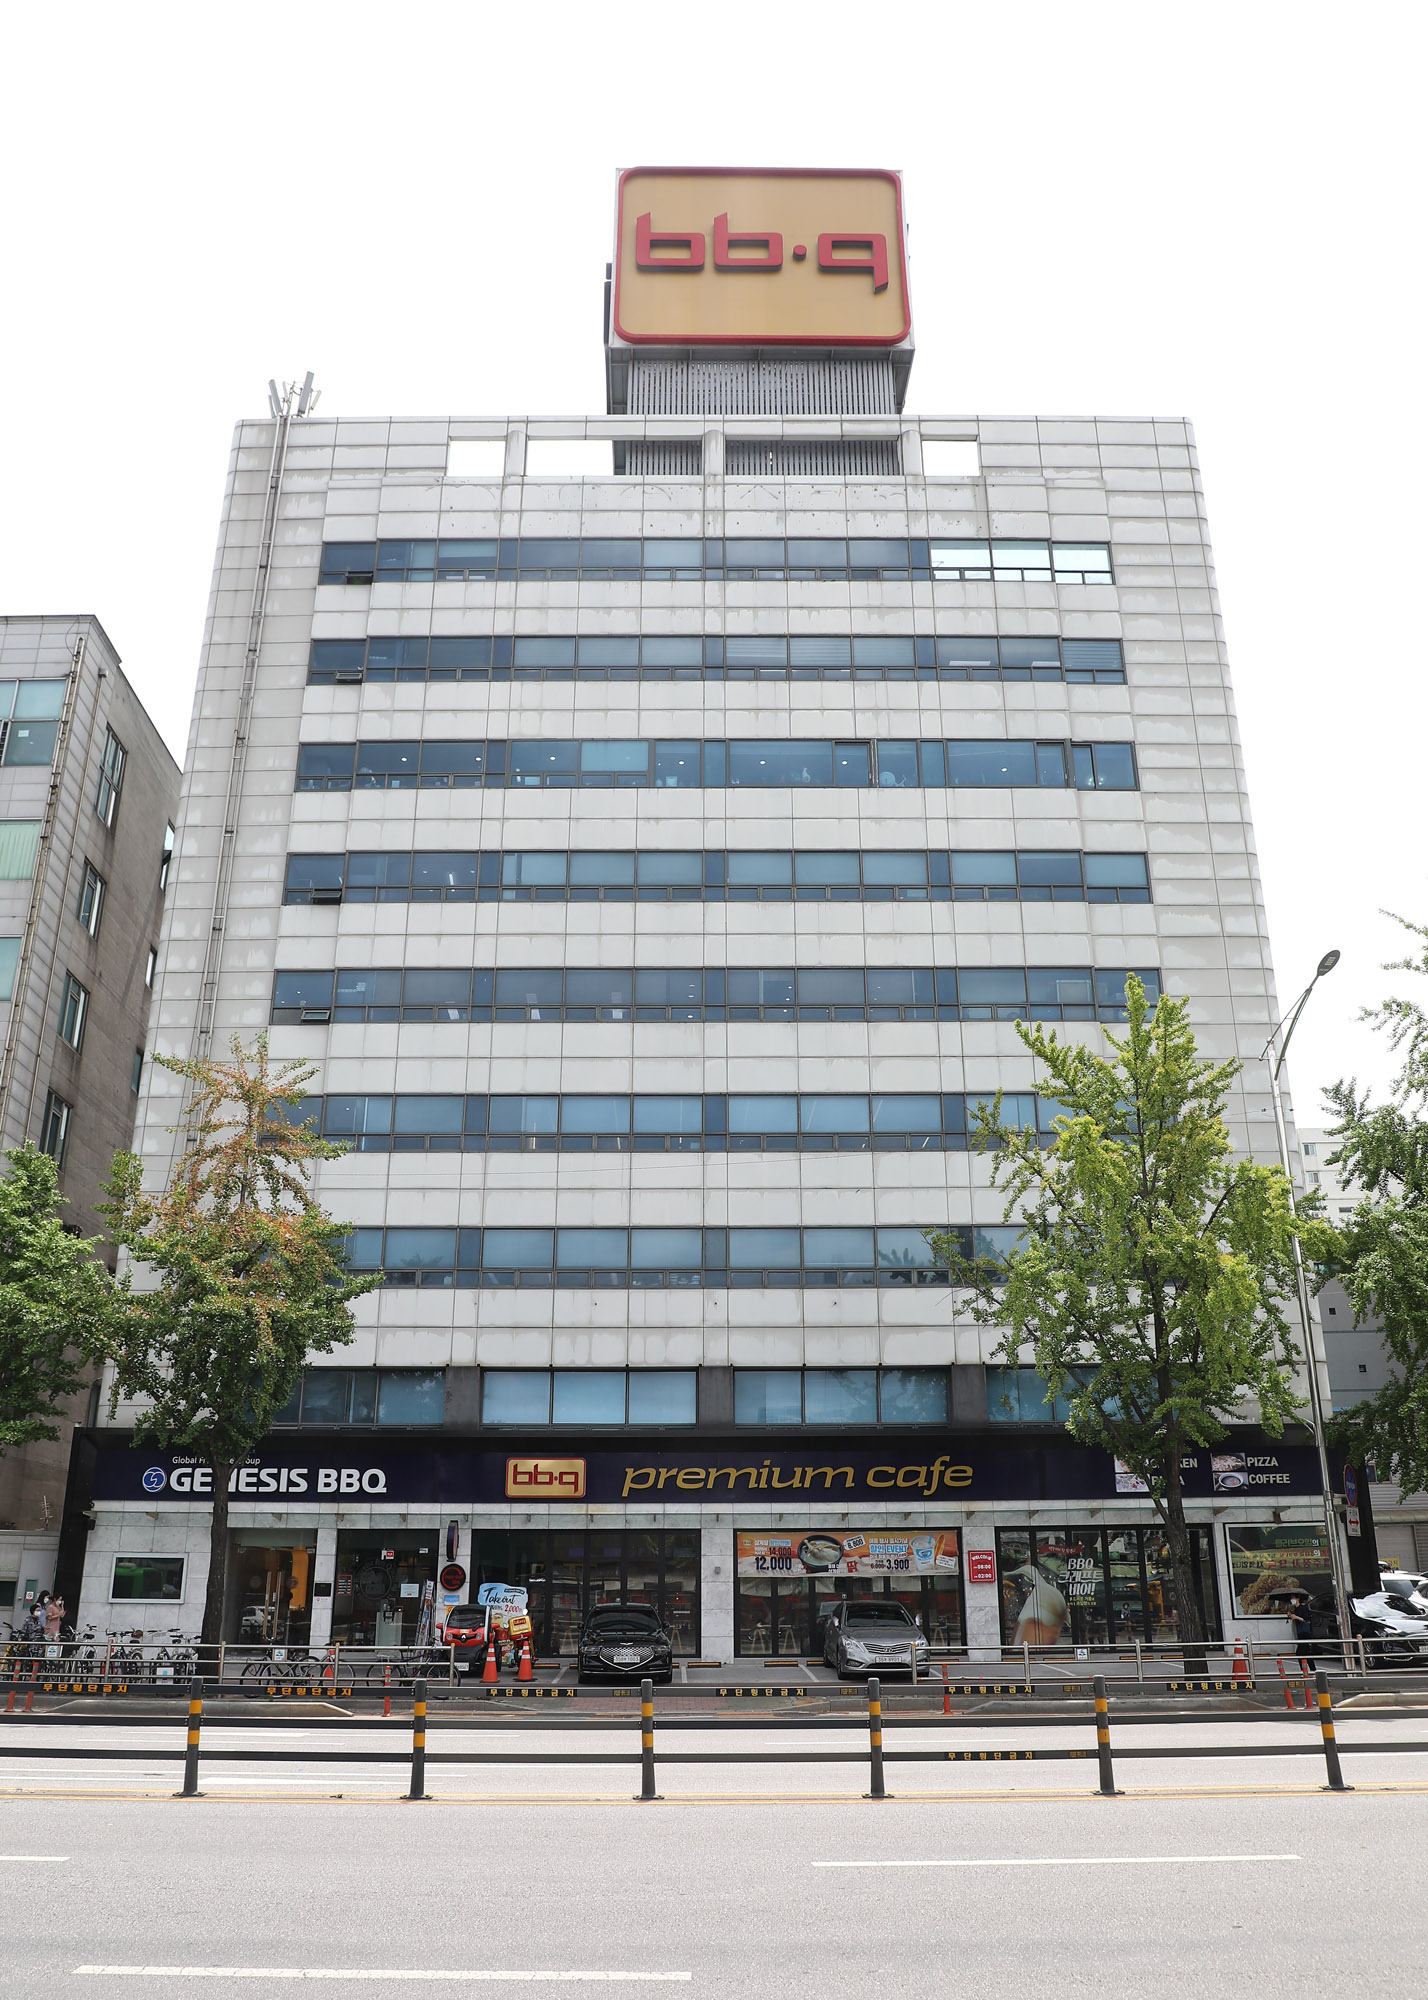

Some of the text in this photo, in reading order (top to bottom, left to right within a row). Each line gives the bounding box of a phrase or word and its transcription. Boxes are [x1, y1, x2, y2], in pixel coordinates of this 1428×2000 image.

[172, 1456, 197, 1464] Global
[1247, 1456, 1278, 1467] PIZZA
[317, 1468, 387, 1493] BBQ
[621, 1456, 973, 1497] premium cafe
[1250, 1473, 1290, 1484] COFFEE
[886, 1545, 908, 1553] EVENT
[755, 1556, 792, 1570] 12,000
[887, 1559, 910, 1570] 3,900
[1068, 1557, 1095, 1570] BBQ
[1058, 1570, 1104, 1583] 크래프트
[1068, 1583, 1096, 1596] 비어!
